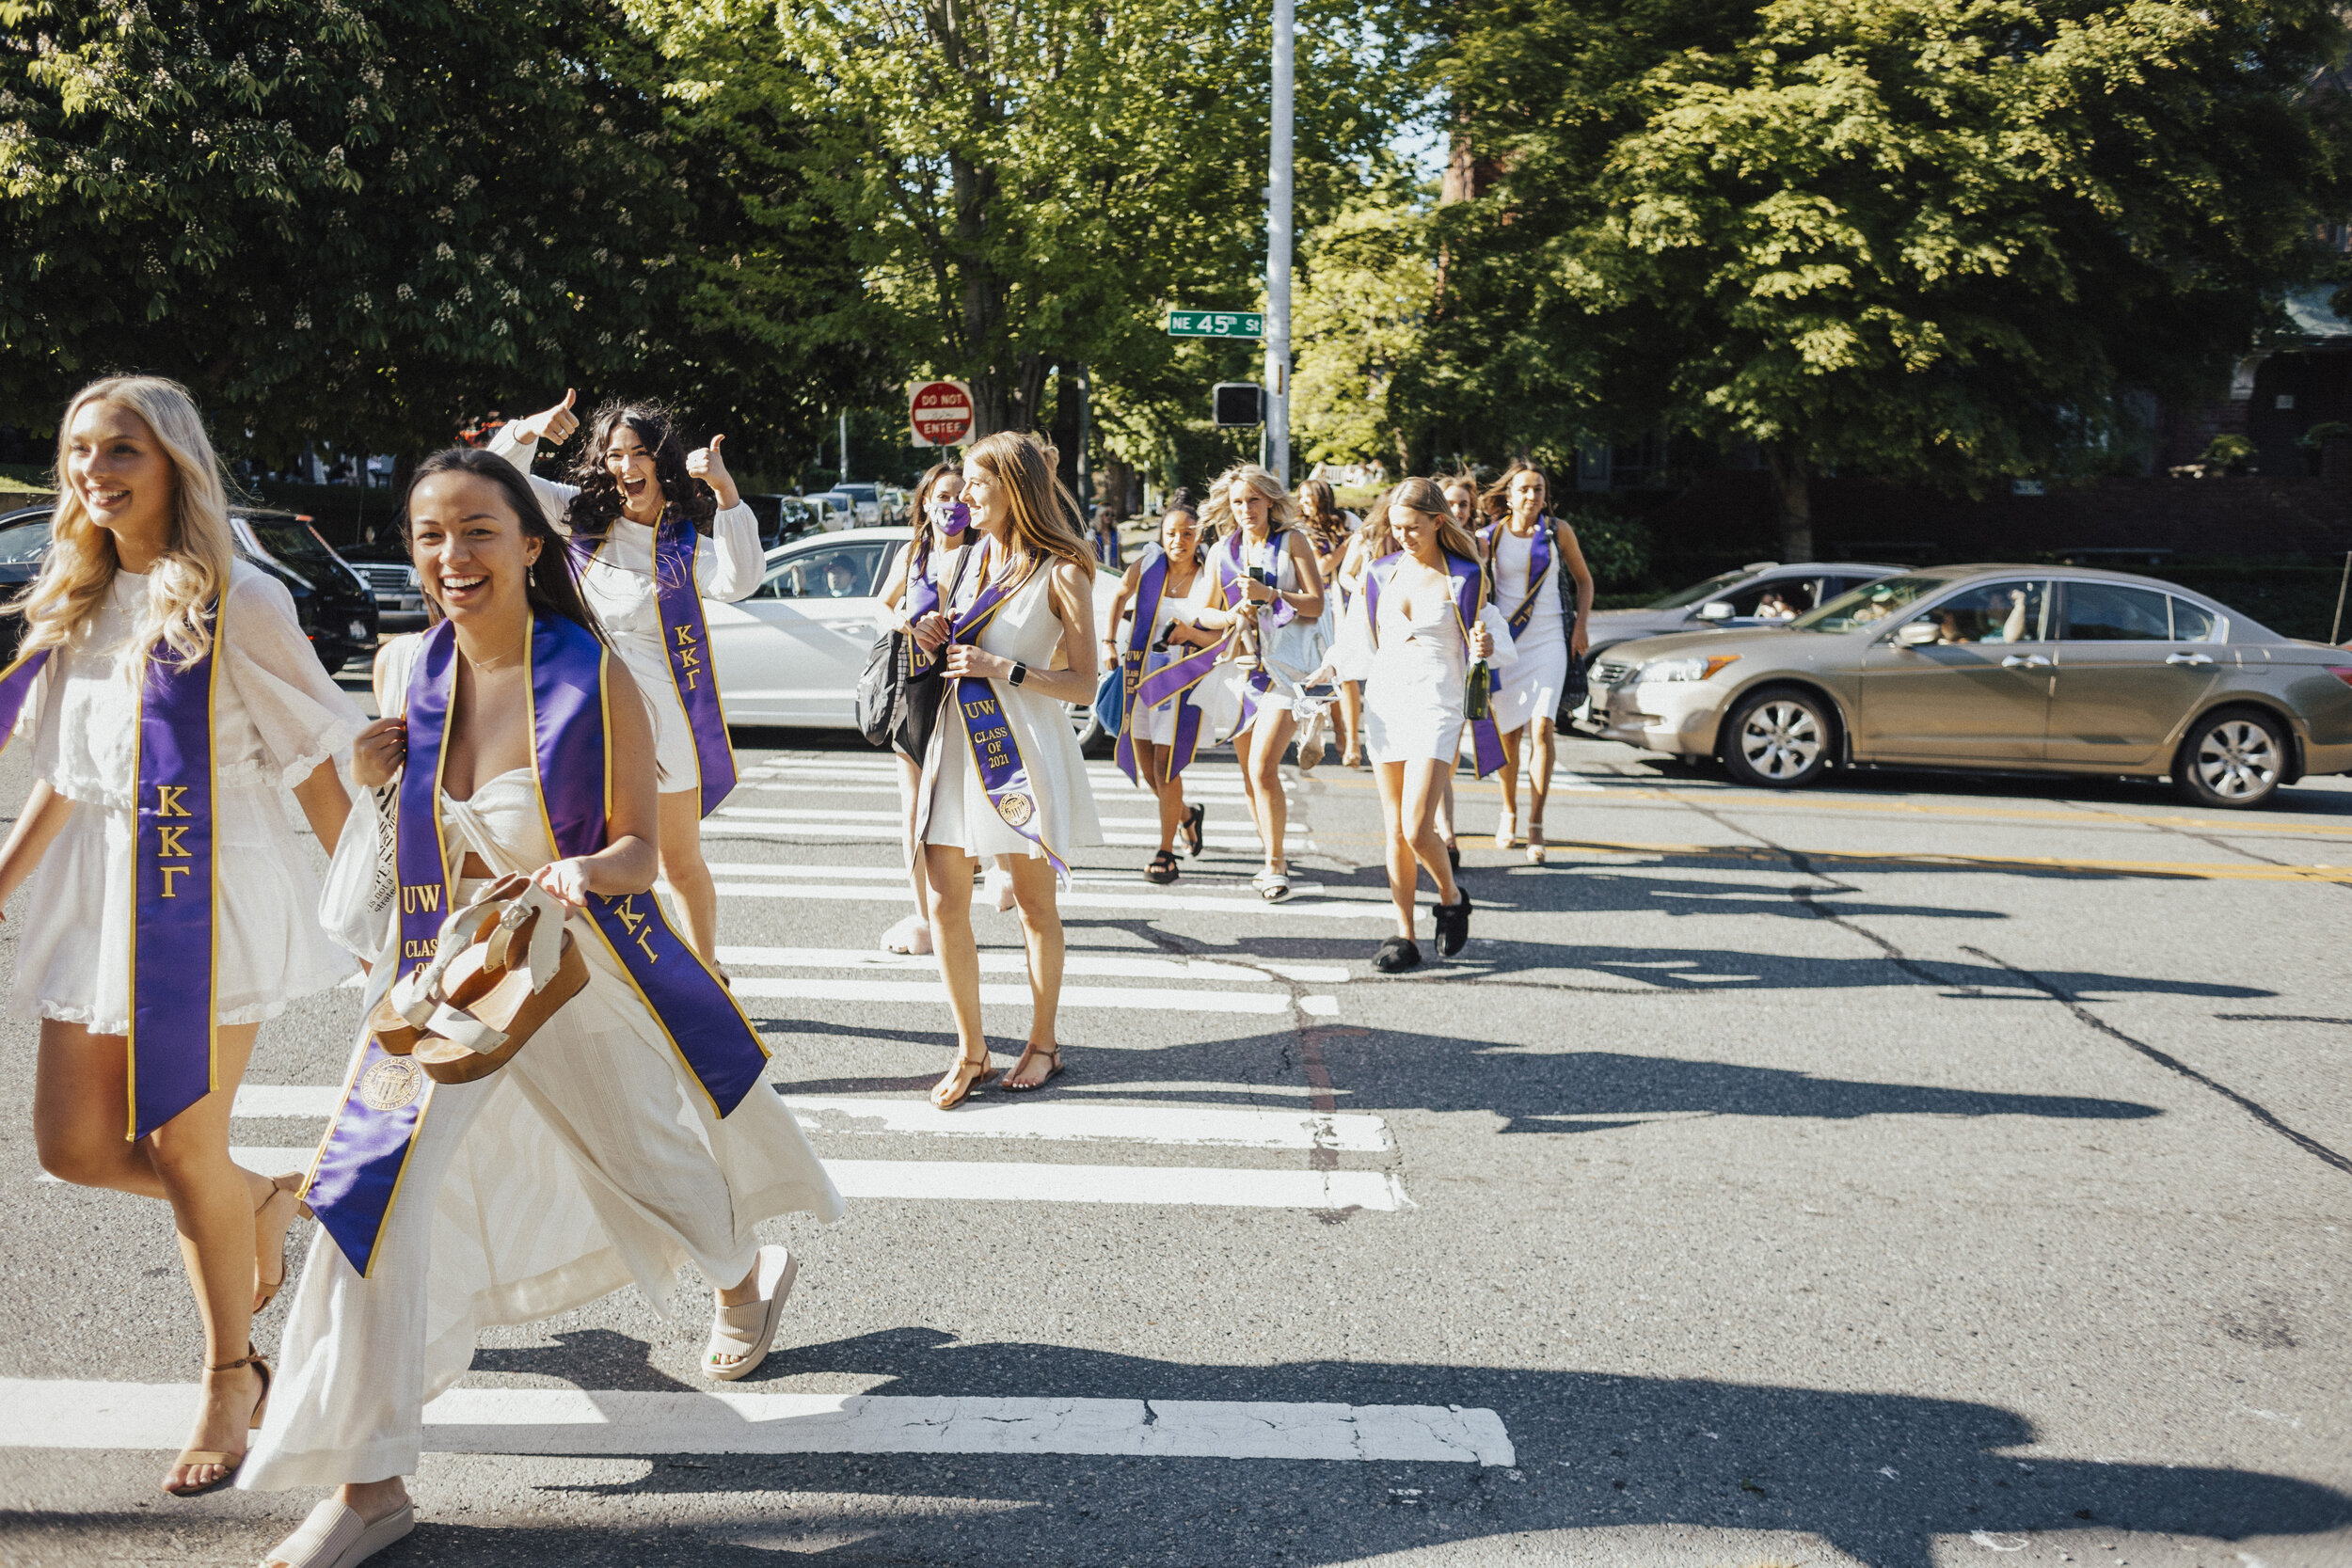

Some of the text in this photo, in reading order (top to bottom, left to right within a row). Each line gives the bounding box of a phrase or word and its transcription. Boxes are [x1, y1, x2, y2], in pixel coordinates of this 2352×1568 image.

[1172, 317, 1191, 329] NE
[1246, 319, 1260, 331] St
[922, 394, 962, 406] DO NOT
[1127, 650, 1143, 661] UW
[964, 699, 995, 719] UW
[974, 726, 1009, 744] CLASS
[987, 740, 1002, 754] OF
[988, 753, 1009, 769] 2021
[373, 883, 389, 901] not
[387, 878, 394, 886] a
[403, 884, 441, 914] UW
[405, 938, 438, 958] CLAS
